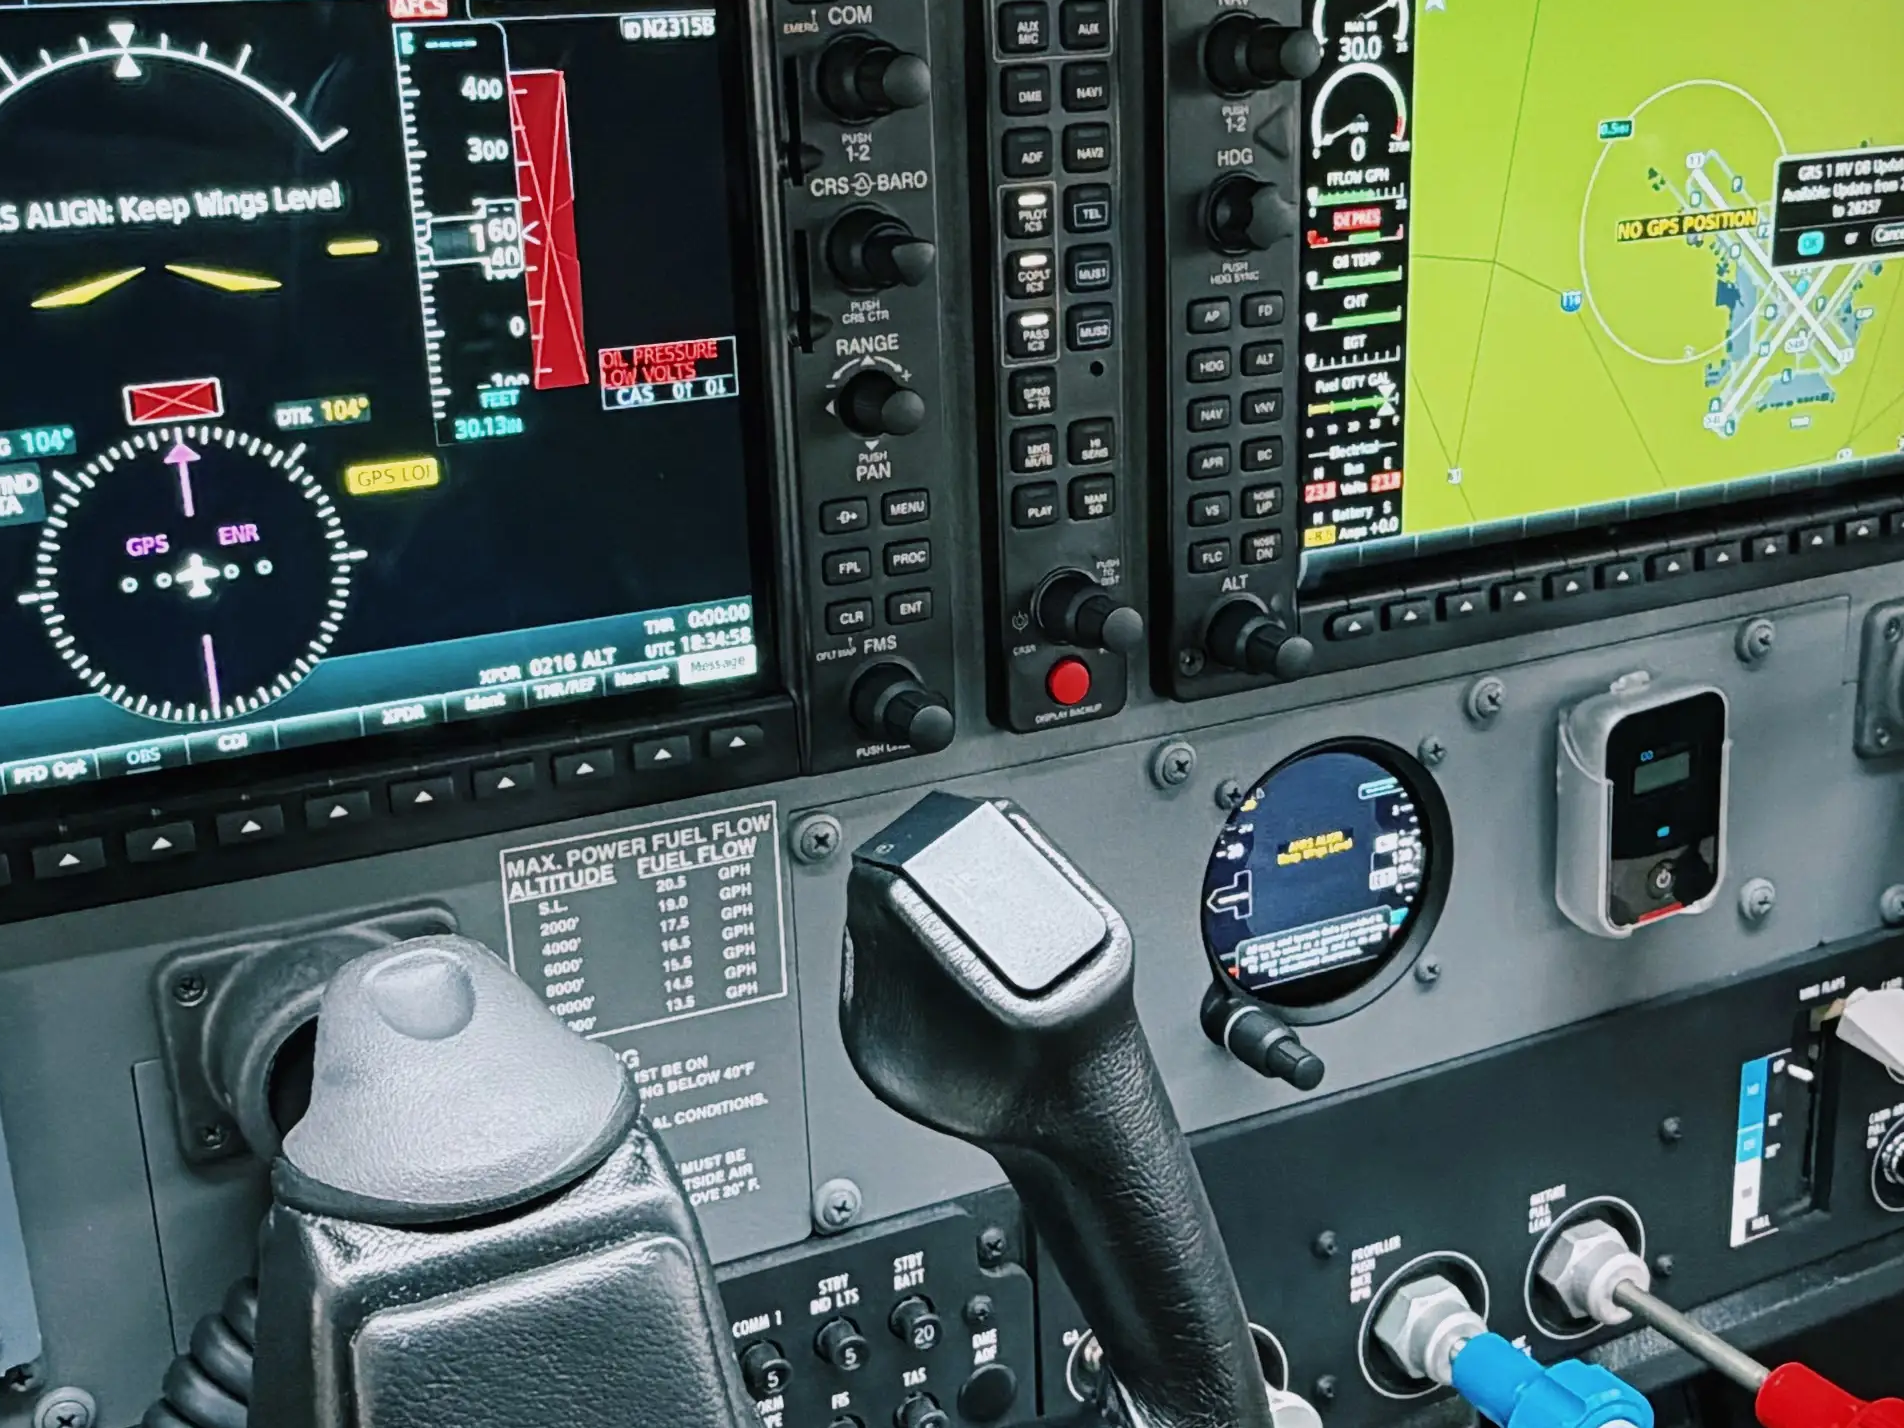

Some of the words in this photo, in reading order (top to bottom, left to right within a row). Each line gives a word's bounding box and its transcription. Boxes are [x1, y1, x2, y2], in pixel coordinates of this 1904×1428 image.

[827, 5, 873, 25] COM
[1338, 37, 1382, 61] 30.0
[1217, 147, 1254, 167] HDG
[25, 198, 115, 230] ALIGN:
[117, 195, 191, 225] Keep
[192, 188, 269, 221] Wings
[271, 180, 342, 213] Level
[1618, 221, 1643, 240] NO
[1647, 215, 1679, 236] GPS
[1683, 208, 1757, 234] POSITION
[601, 349, 628, 369] OIL
[633, 340, 718, 362] PRESSURE
[835, 333, 899, 356] RANGE
[890, 500, 925, 516] MENU
[125, 533, 170, 557] GPS
[217, 523, 260, 546] ENR
[892, 550, 926, 566] PROC
[507, 853, 562, 879] MAX.
[567, 837, 646, 866] POWER
[652, 827, 707, 852] FUEL
[712, 813, 771, 840] FLOW
[509, 864, 615, 901] ALTITUDE
[637, 849, 692, 874] FUEL
[698, 837, 757, 863] FLOW
